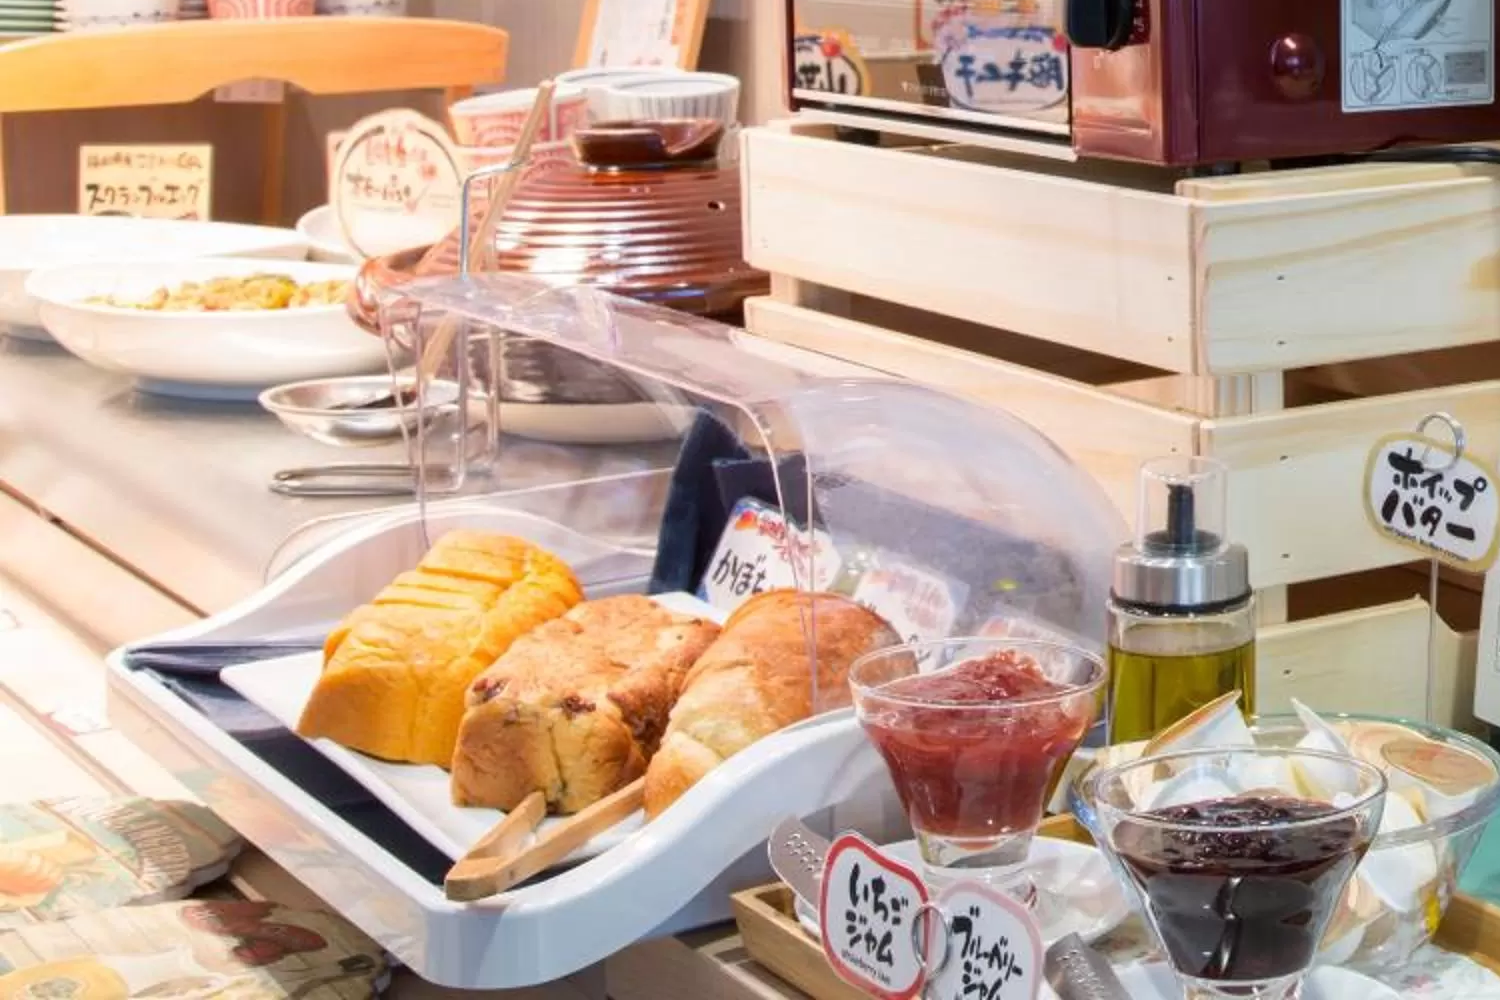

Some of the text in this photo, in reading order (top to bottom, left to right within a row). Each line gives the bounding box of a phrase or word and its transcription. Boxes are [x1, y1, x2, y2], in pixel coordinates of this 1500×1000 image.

[1387, 447, 1487, 512] ホイップ
[1381, 489, 1476, 542] バター
[711, 548, 774, 597] かぼち
[849, 862, 908, 926] いちご
[845, 909, 894, 968] ジャム
[951, 904, 1024, 982] ブルーベリー
